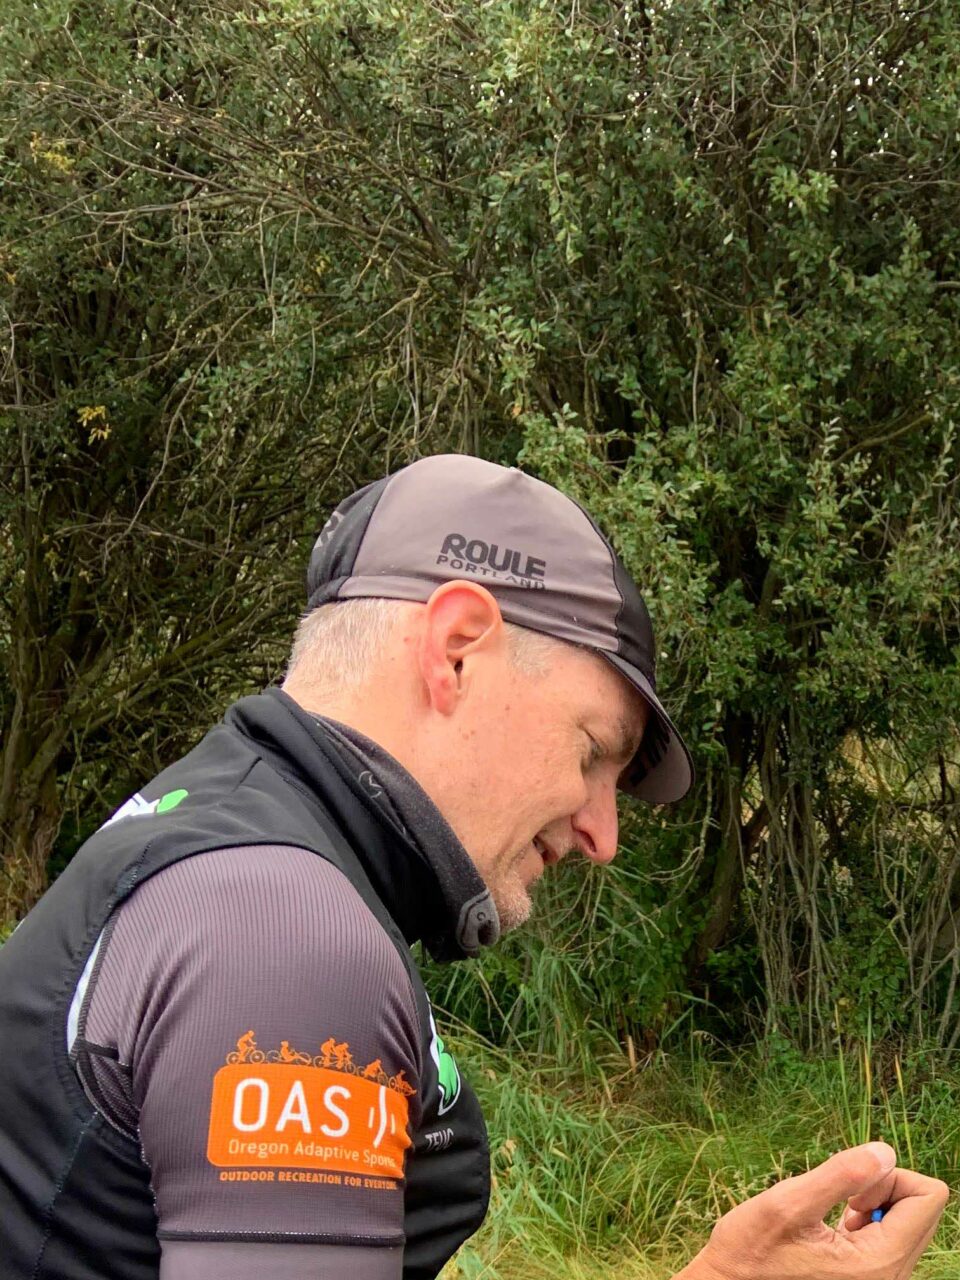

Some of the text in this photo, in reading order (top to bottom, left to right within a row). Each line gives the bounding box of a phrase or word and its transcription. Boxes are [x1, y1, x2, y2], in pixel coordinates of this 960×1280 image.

[436, 555, 546, 590] PORTLAND
[441, 533, 546, 581] ROULE
[232, 1077, 352, 1138] OAS
[228, 1139, 289, 1159] Oregon
[294, 1140, 360, 1161] Adaptive
[220, 1171, 275, 1182] OUTDOOR
[278, 1171, 342, 1185] RECREATION
[344, 1175, 362, 1187] FOR
